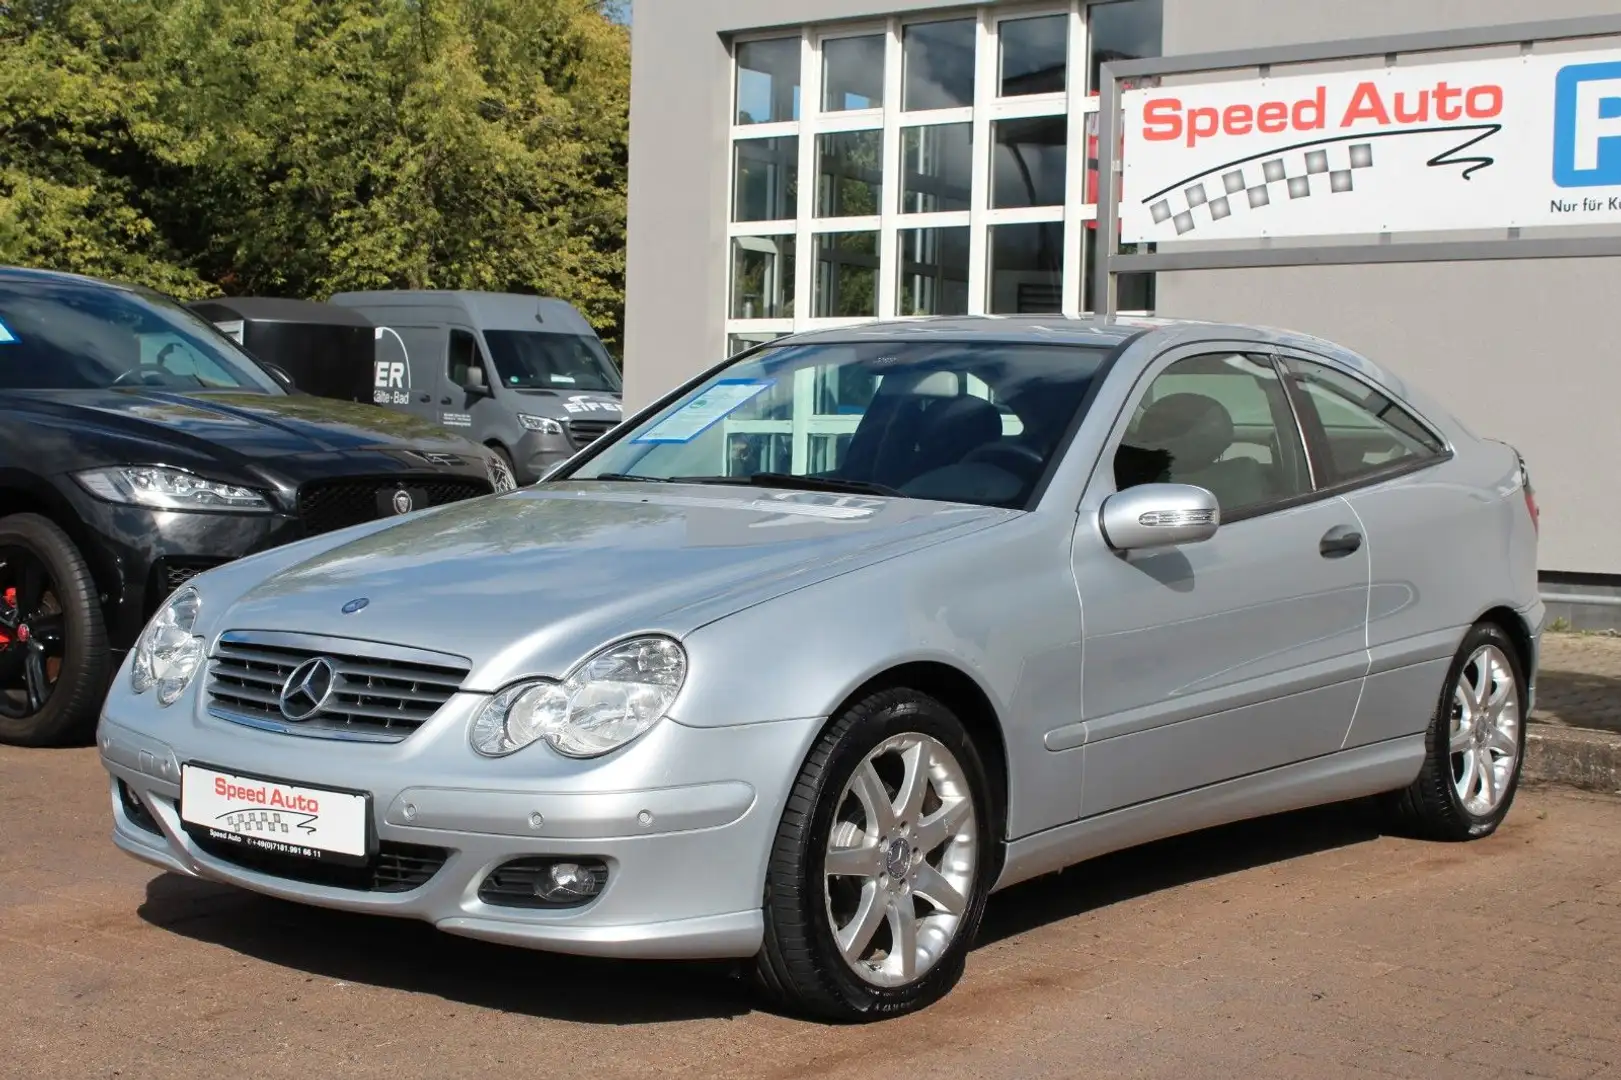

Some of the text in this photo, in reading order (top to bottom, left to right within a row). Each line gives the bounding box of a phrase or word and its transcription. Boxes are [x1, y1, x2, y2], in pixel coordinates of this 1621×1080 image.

[1142, 81, 1503, 147] Speed Auto
[1550, 196, 1621, 213] Nur für K
[374, 361, 405, 388] ER
[215, 777, 319, 812] Speed Auto
[209, 828, 242, 843] Speed Auto
[313, 850, 321, 858] 11
